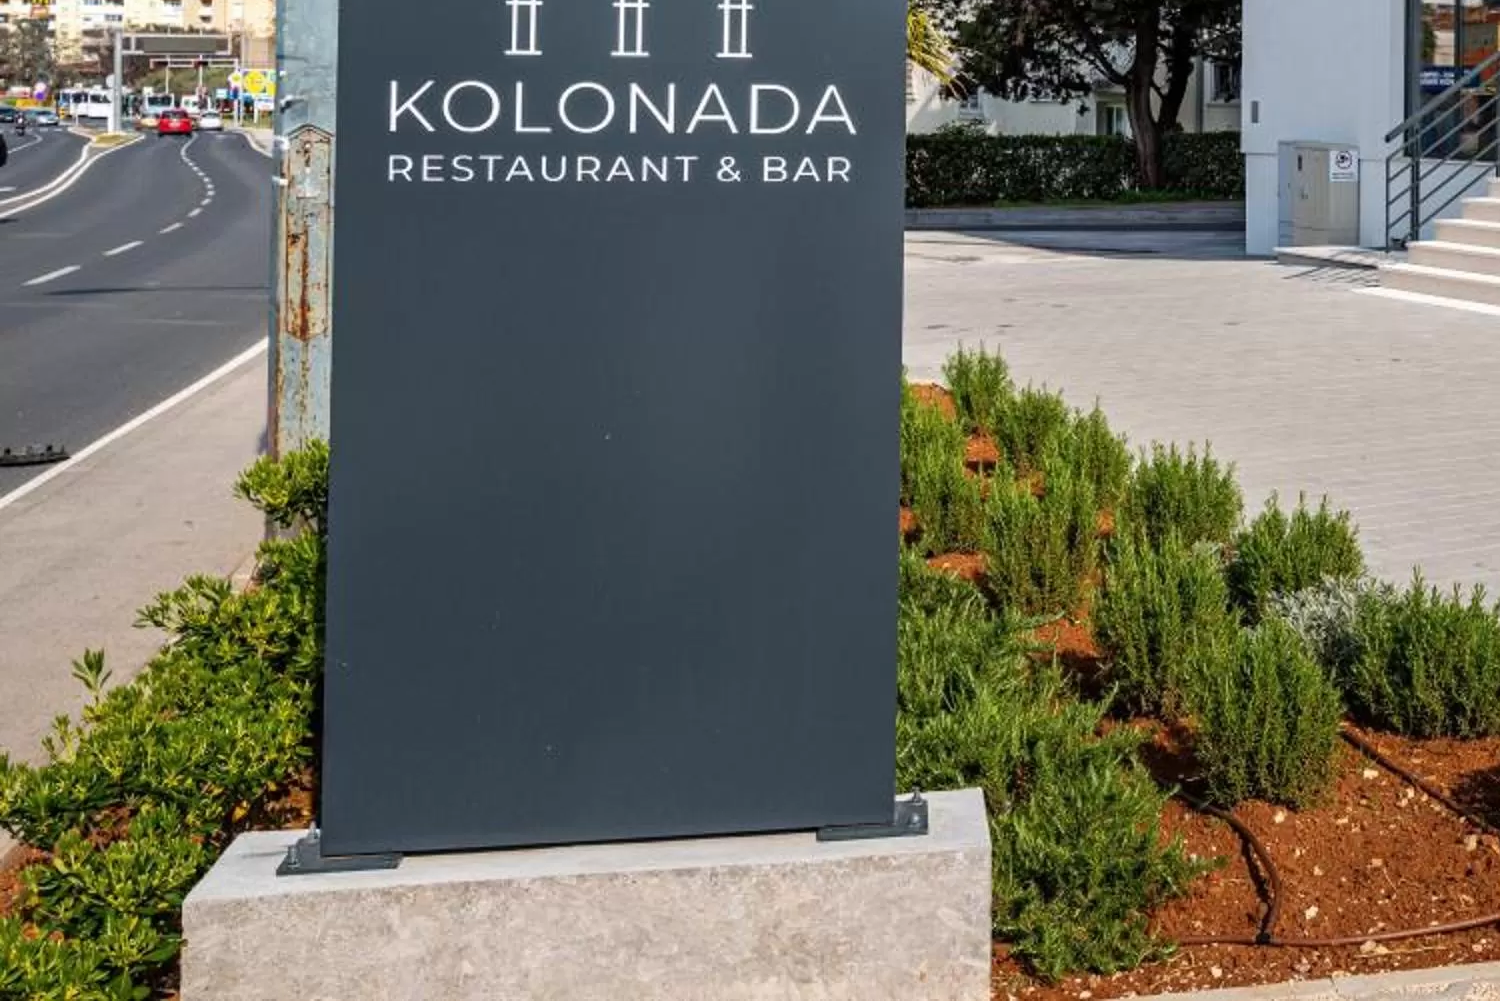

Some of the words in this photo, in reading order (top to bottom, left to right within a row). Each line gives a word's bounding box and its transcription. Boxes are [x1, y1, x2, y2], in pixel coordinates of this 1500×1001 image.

[388, 79, 857, 136] KOLONADA
[388, 154, 699, 183] RESTAURANT
[716, 155, 742, 183] &
[762, 155, 852, 183] BAR
